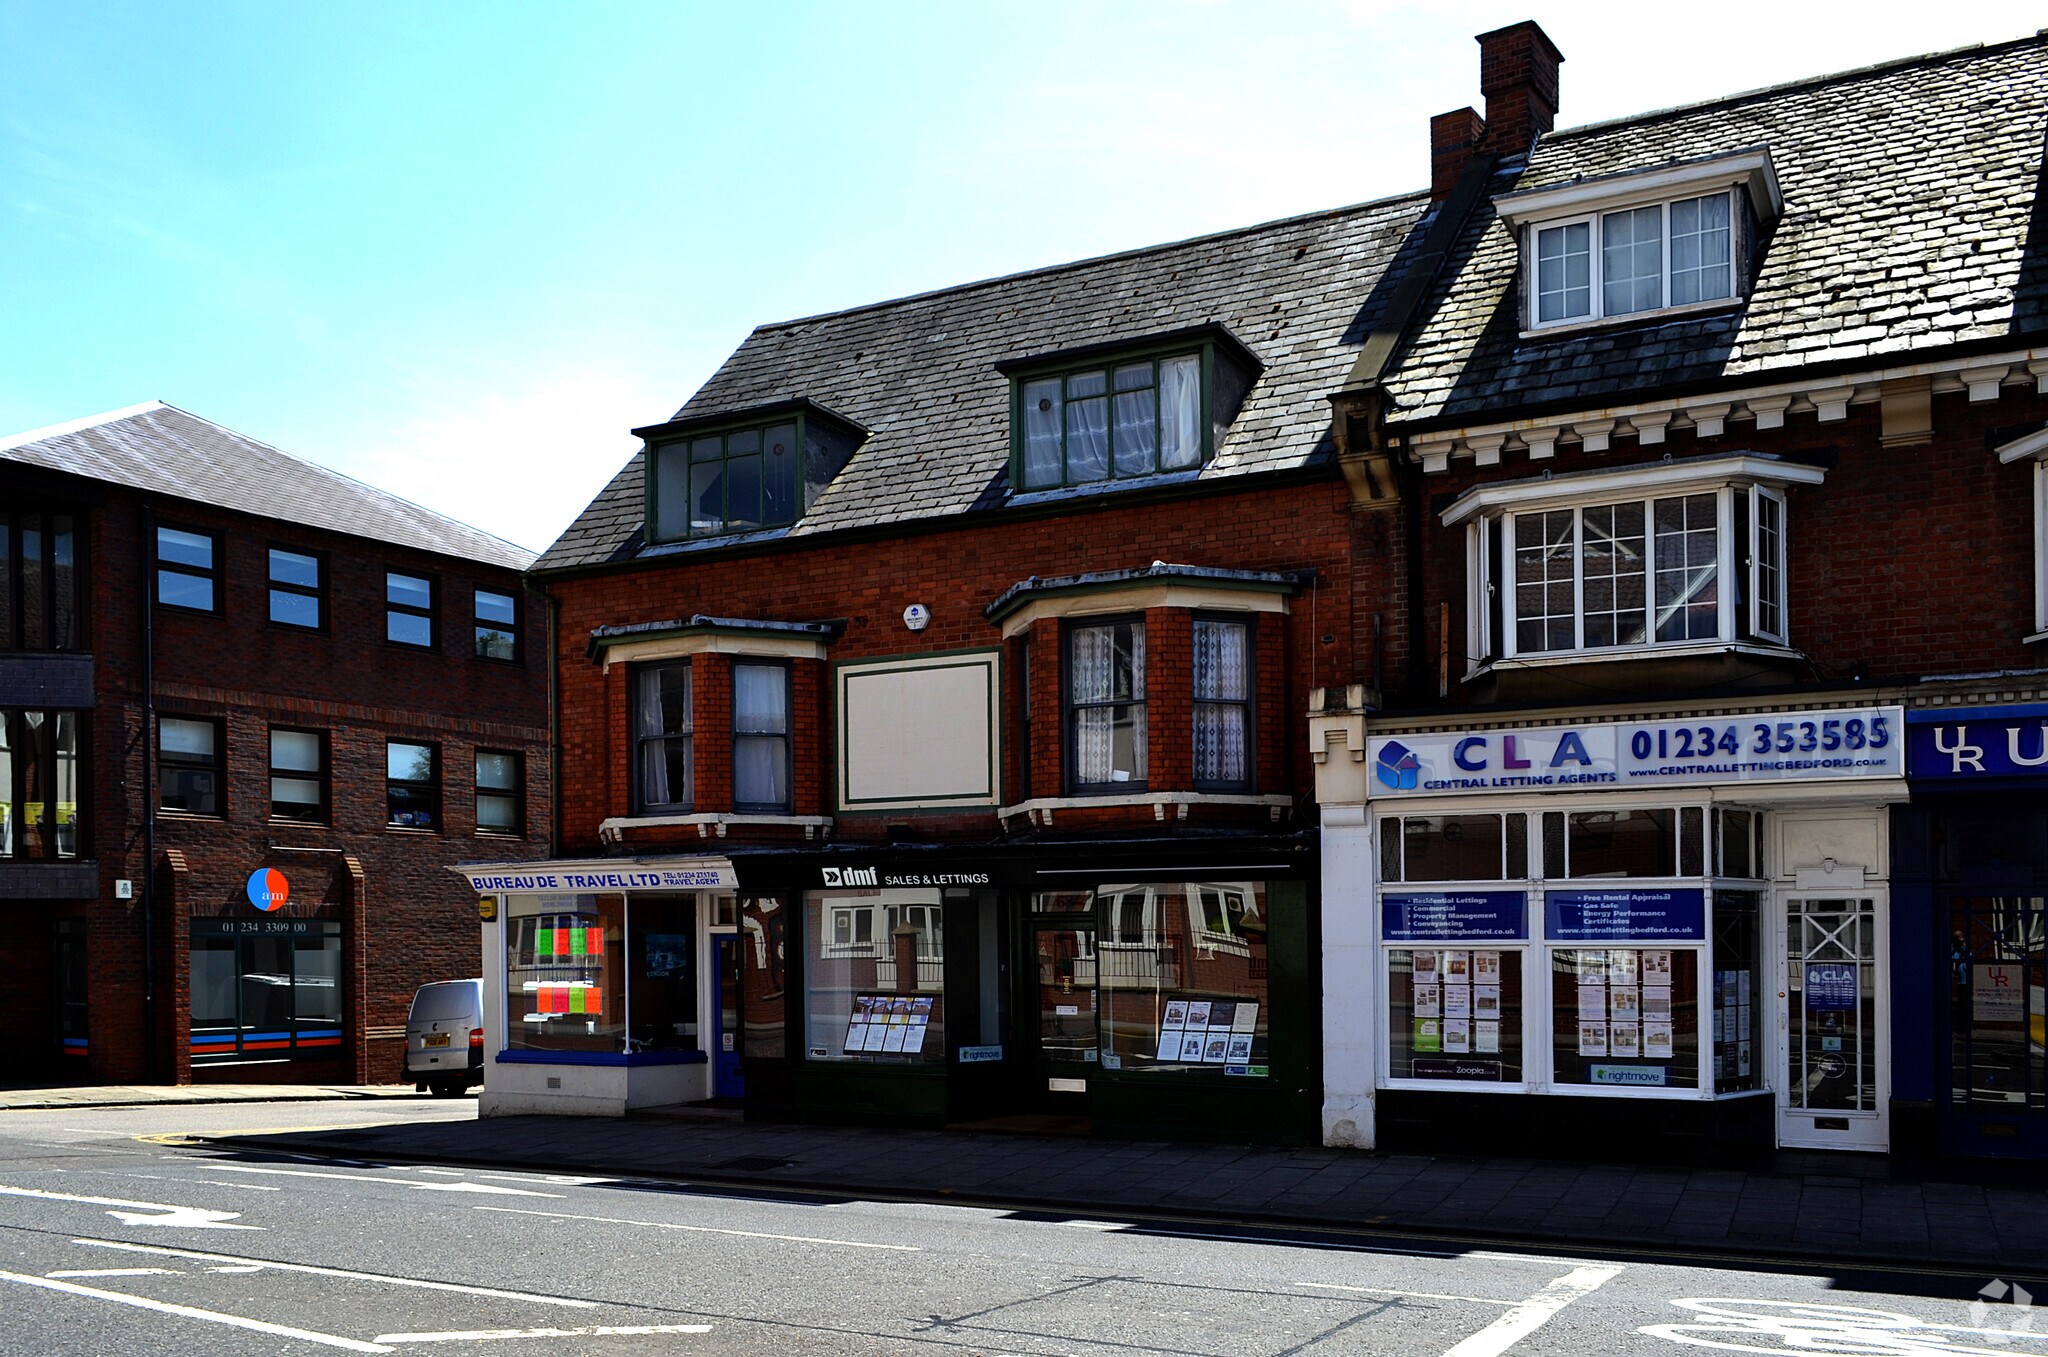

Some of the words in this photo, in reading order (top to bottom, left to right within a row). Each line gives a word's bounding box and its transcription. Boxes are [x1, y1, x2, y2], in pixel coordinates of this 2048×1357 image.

[1631, 725, 1739, 759] 01234
[1753, 717, 1889, 754] 353585
[1424, 778, 1488, 789] CENTRAL
[1492, 776, 1553, 787] LETTING
[1558, 772, 1616, 784] AGENTS
[842, 867, 878, 886] dmf
[885, 875, 921, 885] SALES
[923, 875, 931, 885] &
[933, 874, 989, 884] LETTINGS
[472, 877, 535, 890] BUREAU
[536, 876, 558, 889] DE
[564, 874, 629, 888] TRAVEL
[629, 874, 661, 887] LTD
[262, 892, 284, 901] am
[1456, 897, 1488, 905] Lettings
[1632, 893, 1671, 902] Appraisal
[1413, 912, 1446, 921] Property
[1448, 912, 1497, 920] Management
[1583, 910, 1612, 918] Energy
[222, 922, 234, 932] 01
[240, 922, 258, 932] 234
[265, 922, 289, 932] 3309
[294, 922, 306, 932] 00
[1413, 920, 1464, 928] Conveyancing
[1391, 928, 1515, 936] www.centrallettingbedford.co.uk
[1557, 926, 1693, 934] www.centrallettingbedford.co.uk
[1822, 970, 1853, 981] CLA
[969, 1050, 999, 1060] rightmove
[1609, 1071, 1659, 1083] rightmove
